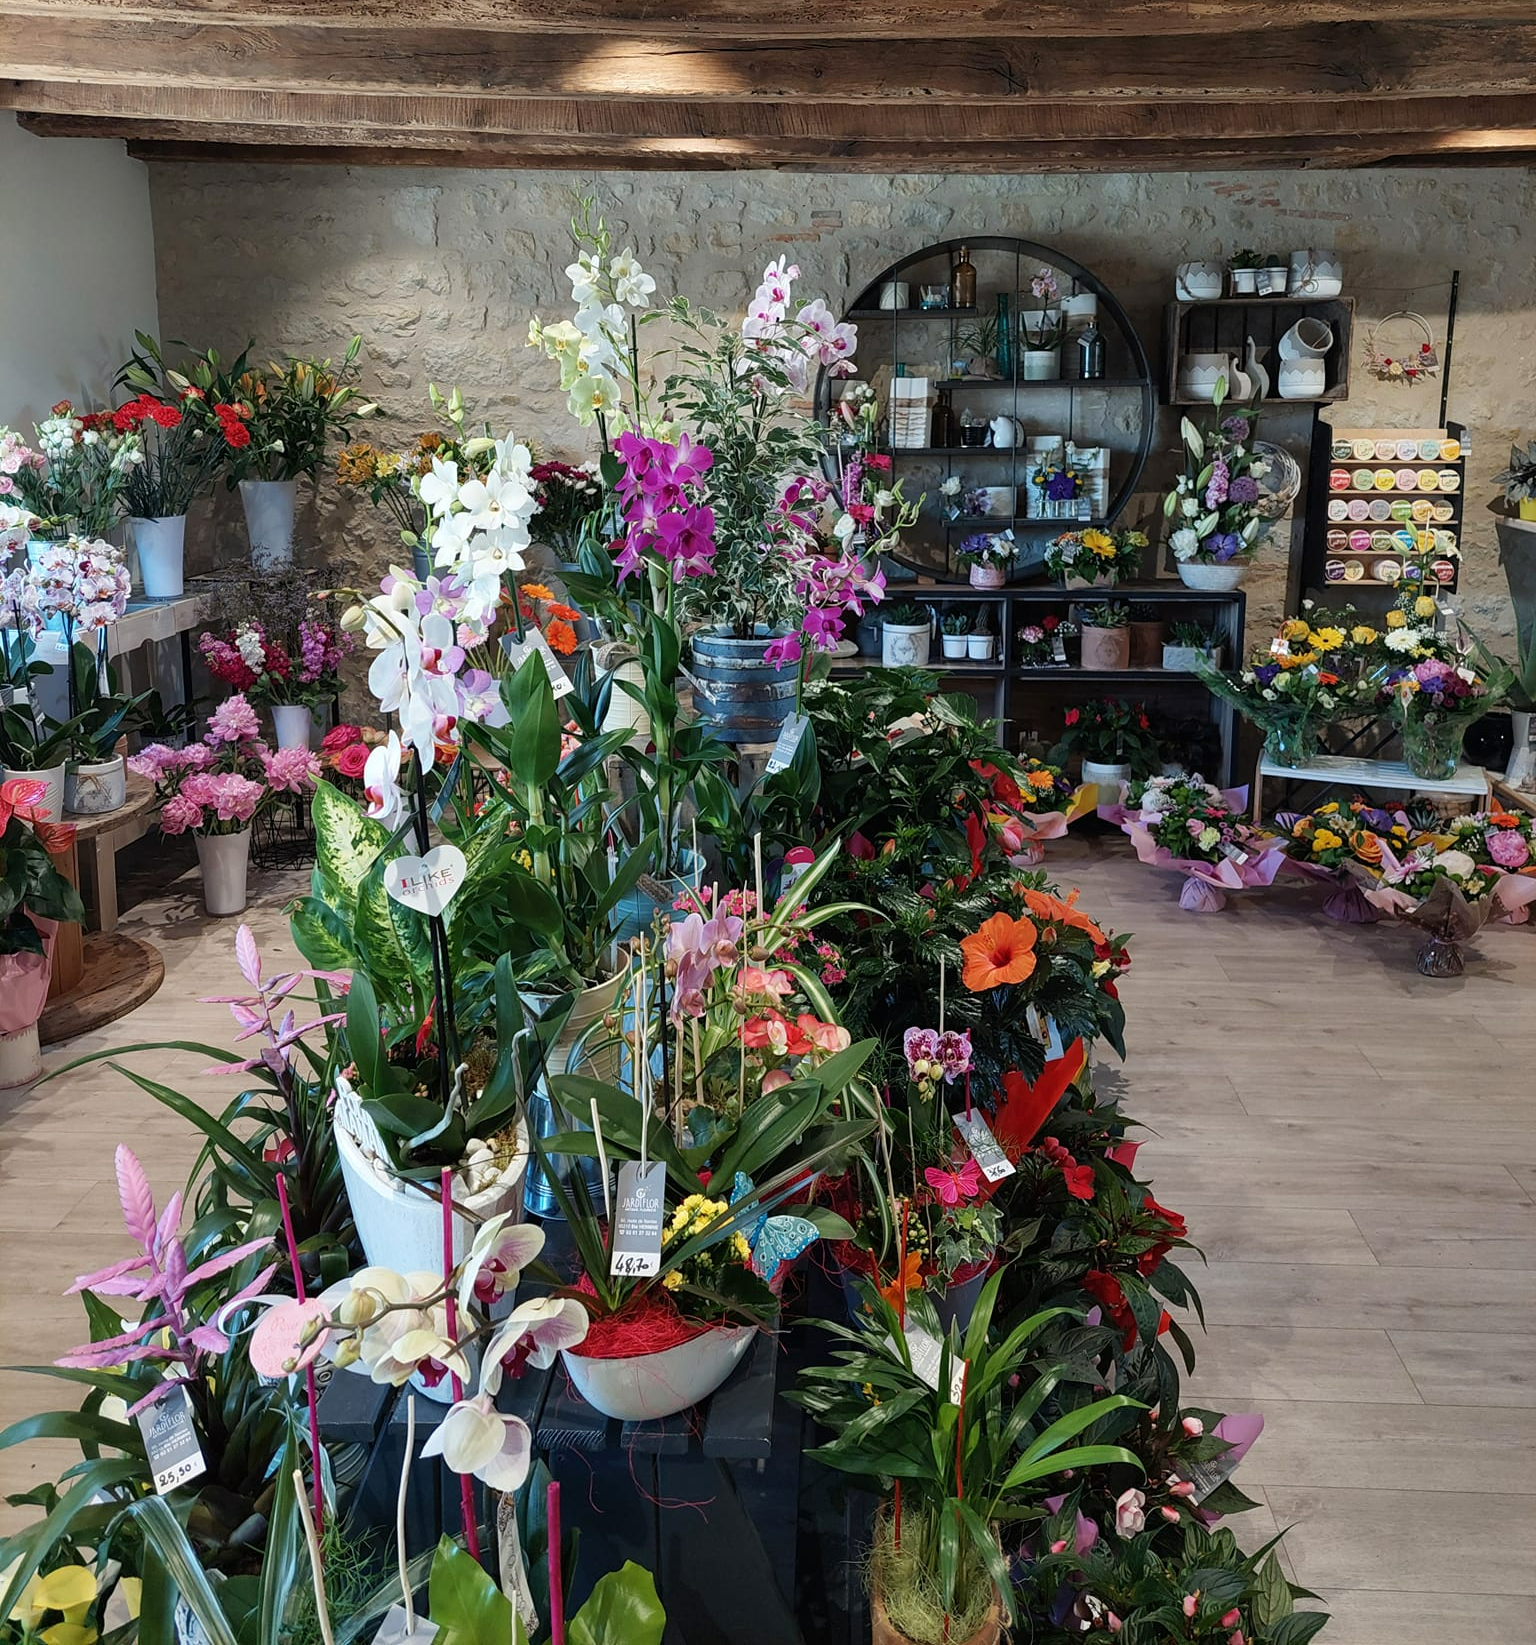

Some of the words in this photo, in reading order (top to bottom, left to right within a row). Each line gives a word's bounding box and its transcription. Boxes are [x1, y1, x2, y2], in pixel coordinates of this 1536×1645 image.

[402, 876, 456, 896] orchids
[410, 867, 453, 887] LIKE
[621, 1197, 660, 1210] JARDIFLOR
[615, 1254, 650, 1274] 48,70
[149, 1411, 187, 1438] JARDIFLOR
[159, 1464, 192, 1486] 25,50
